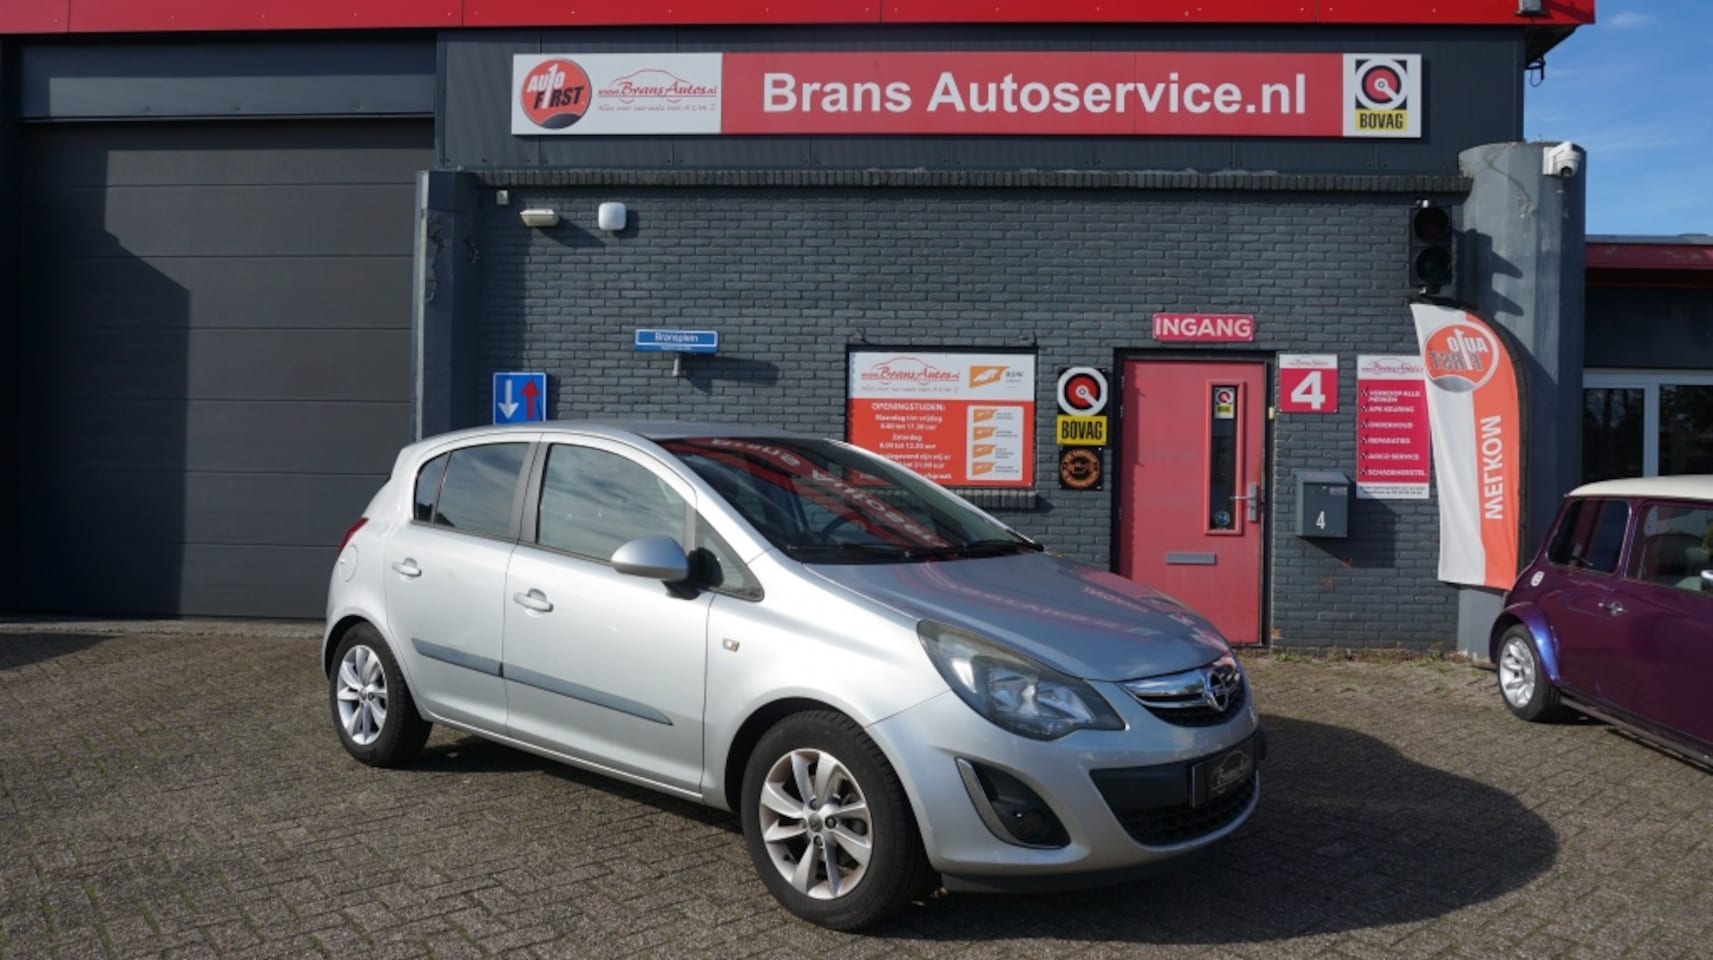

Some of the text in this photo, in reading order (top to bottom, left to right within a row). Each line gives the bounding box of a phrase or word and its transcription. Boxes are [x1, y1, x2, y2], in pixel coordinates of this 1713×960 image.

[763, 71, 1305, 115] Brans Autoservice.nl
[1360, 113, 1404, 130] BOVAG
[1155, 318, 1251, 337] INGANG
[1290, 370, 1326, 410] 4
[1061, 420, 1102, 440] BOVAG
[1316, 510, 1326, 529] 4
